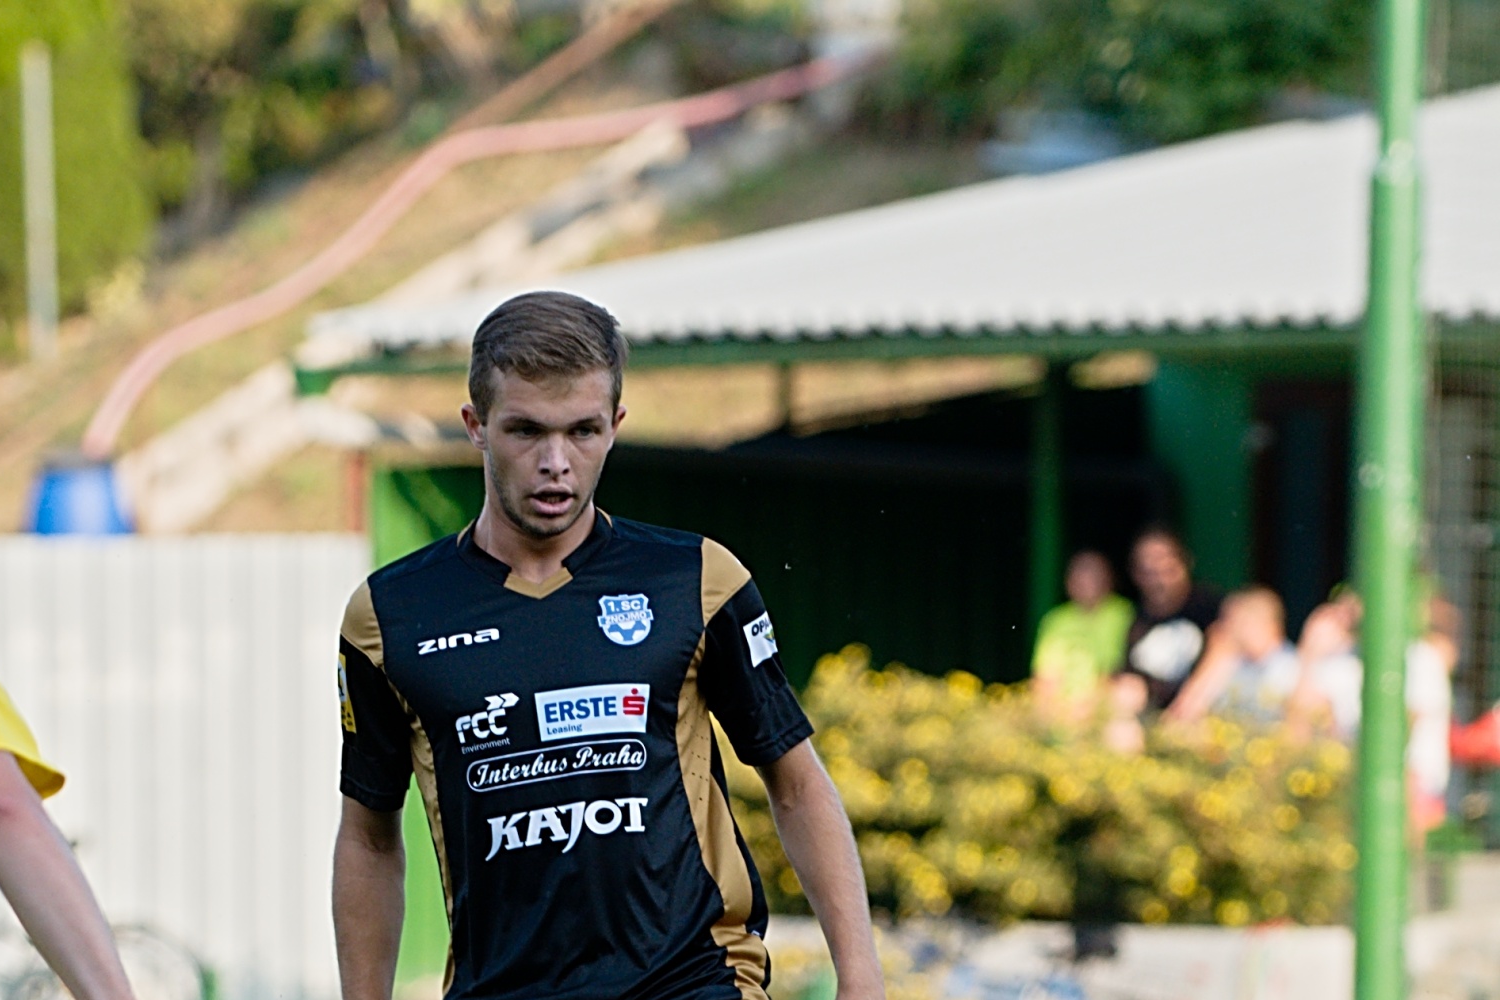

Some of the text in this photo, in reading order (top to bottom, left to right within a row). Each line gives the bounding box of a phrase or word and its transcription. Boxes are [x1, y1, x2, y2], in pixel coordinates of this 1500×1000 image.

[605, 611, 647, 624] ZNOJMO
[620, 600, 641, 611] SC
[417, 627, 501, 655] zina
[543, 696, 618, 724] ERSTE
[455, 707, 509, 744] FCC
[546, 723, 583, 736] Leasing
[461, 736, 511, 755] Environment
[472, 743, 644, 787] Interbus Praha
[485, 797, 649, 862] KAJOT
